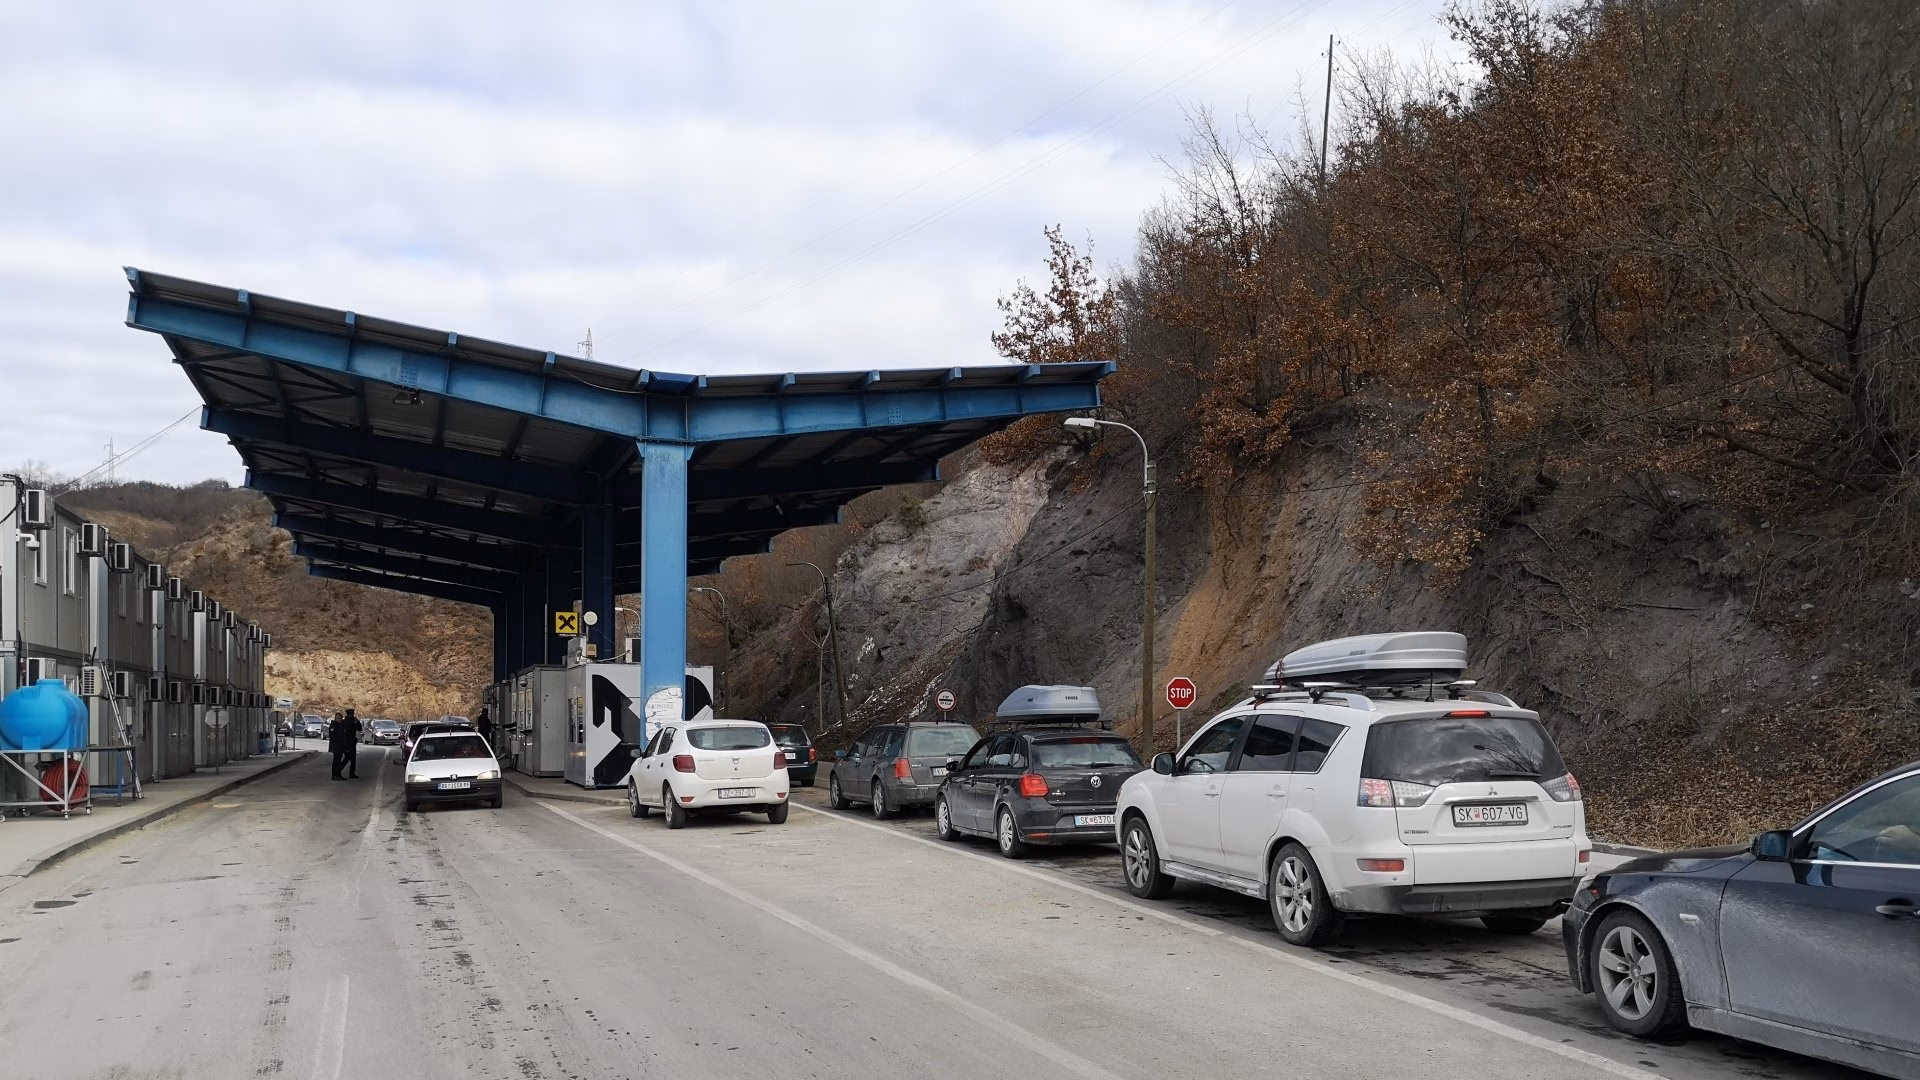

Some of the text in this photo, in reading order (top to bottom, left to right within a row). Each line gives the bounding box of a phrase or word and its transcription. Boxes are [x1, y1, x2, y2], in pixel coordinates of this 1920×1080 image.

[1170, 687, 1192, 699] STOP
[1458, 807, 1474, 821] SK
[1080, 816, 1089, 825] SK
